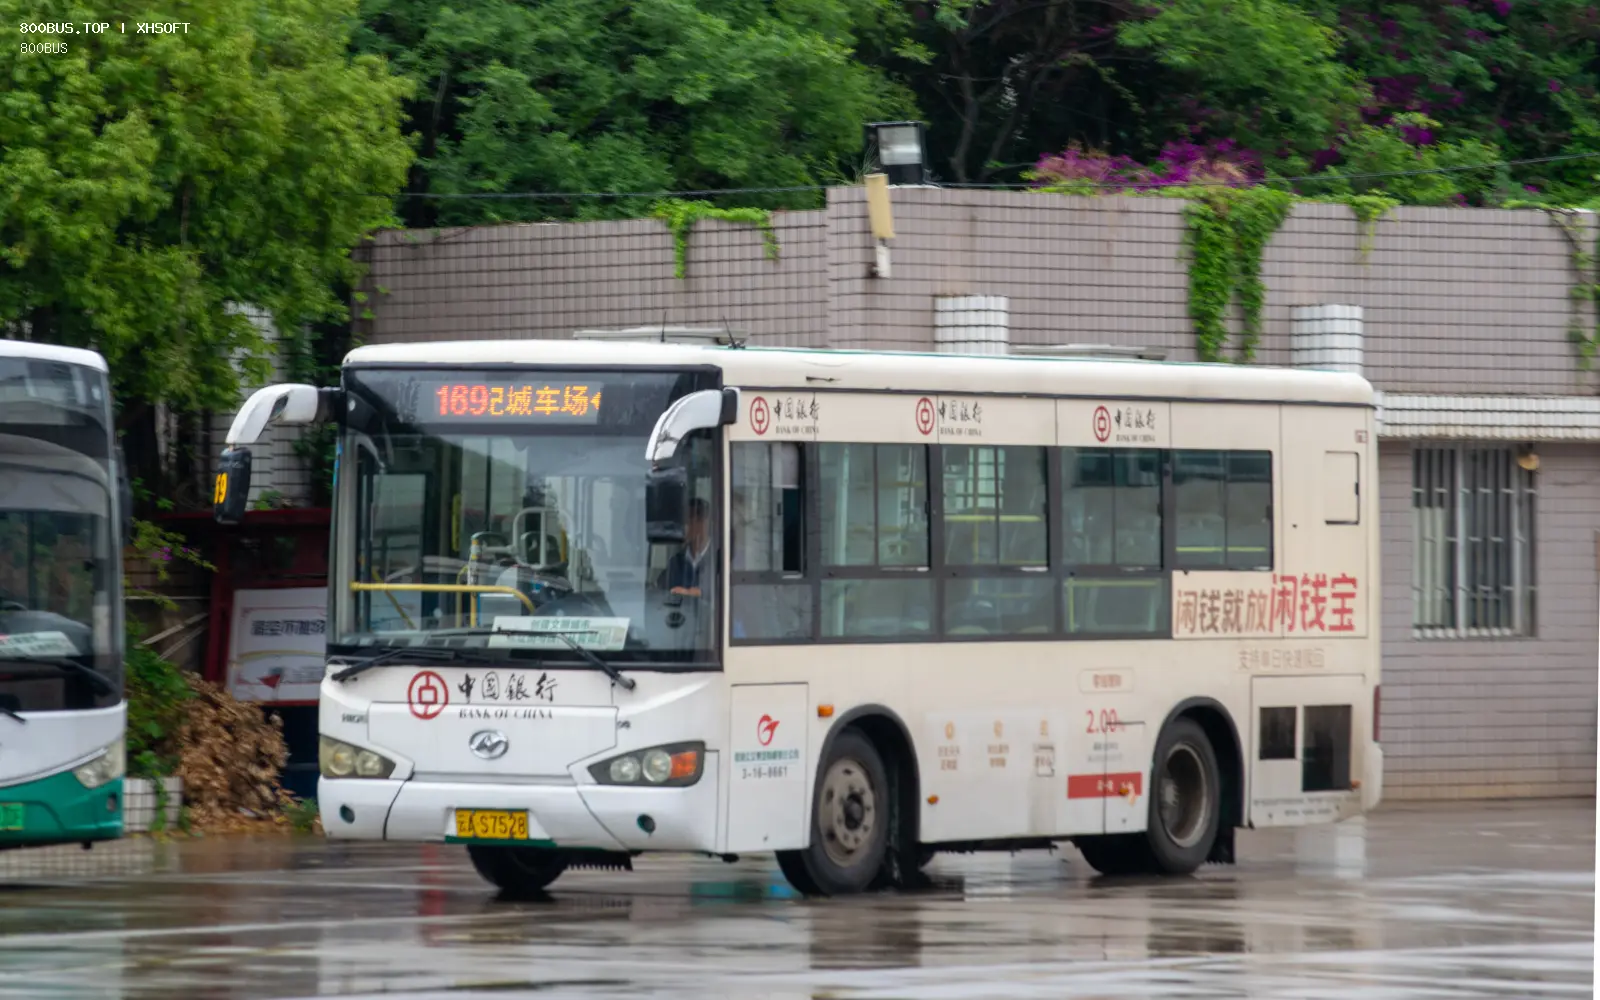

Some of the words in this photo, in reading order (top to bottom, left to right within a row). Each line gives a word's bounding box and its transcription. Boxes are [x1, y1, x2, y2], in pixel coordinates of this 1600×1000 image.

[775, 426, 791, 434] BANK
[940, 427, 955, 435] BANK
[458, 708, 490, 719] BANK
[494, 708, 507, 719] OF
[511, 708, 553, 720] CHINA
